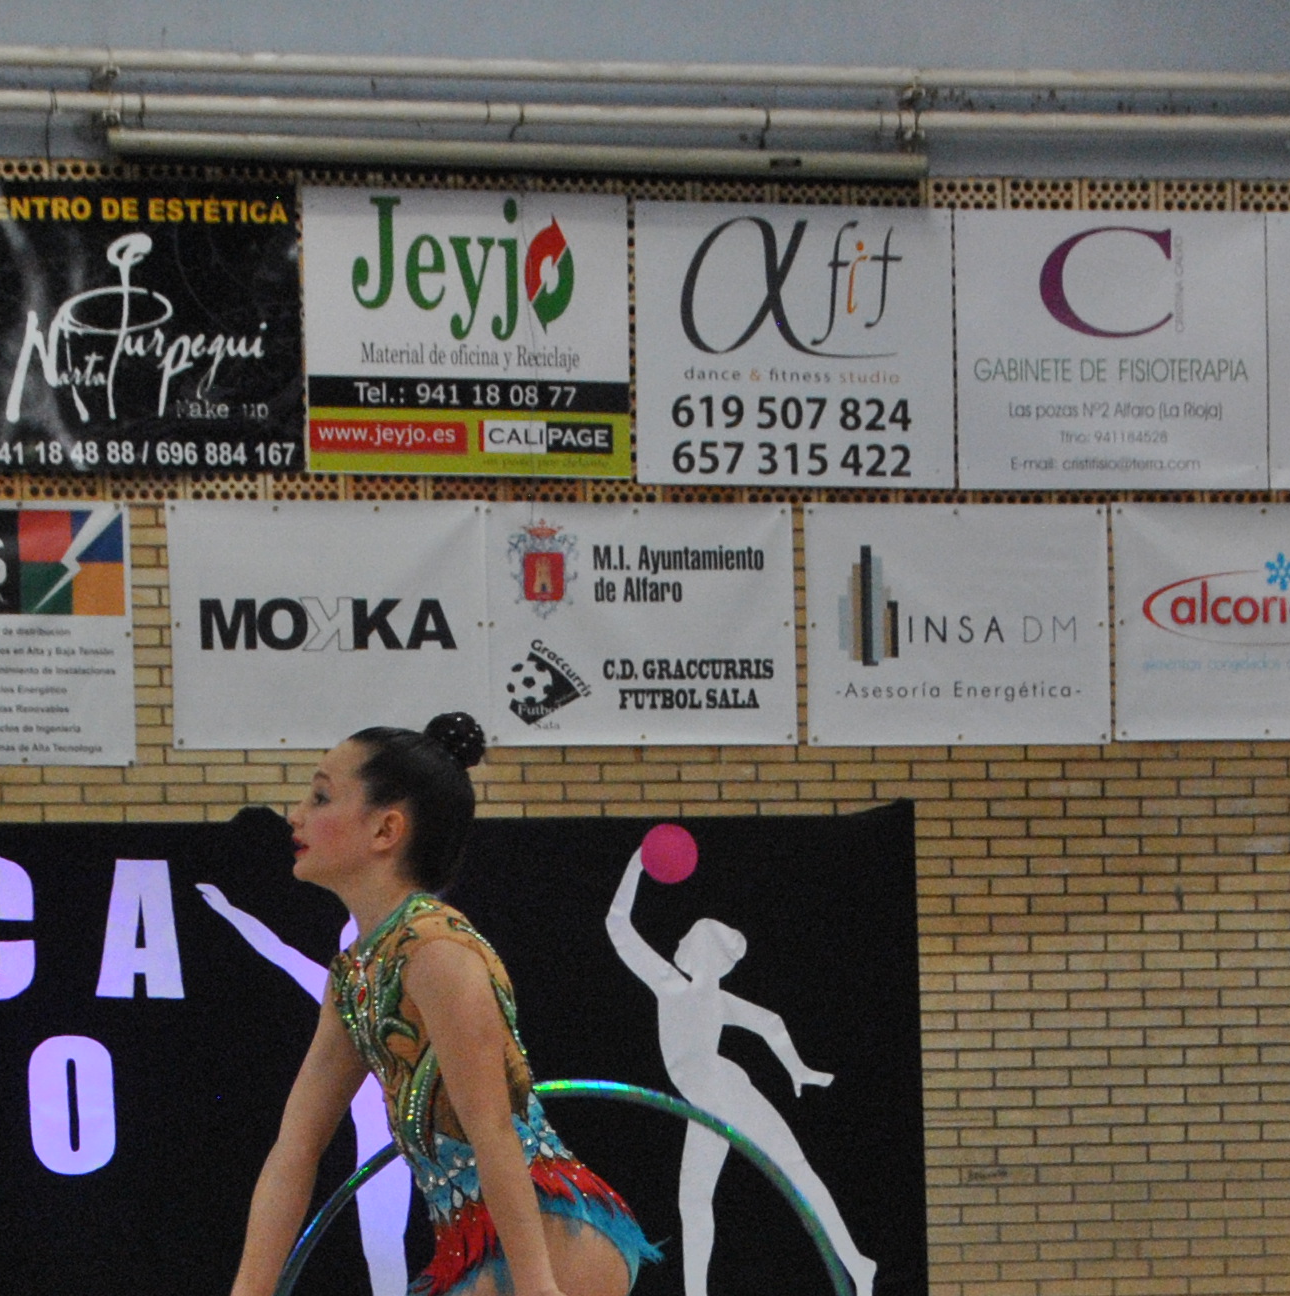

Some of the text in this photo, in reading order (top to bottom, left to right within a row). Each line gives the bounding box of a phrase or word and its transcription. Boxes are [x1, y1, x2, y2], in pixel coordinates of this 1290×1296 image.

[101, 197, 139, 222] DE
[148, 194, 289, 223] ESTÉTICA
[351, 195, 575, 341] Jeyjo
[1039, 225, 1173, 338] C
[361, 342, 580, 373] Material de oficina y Reciclaje
[973, 358, 1248, 383] GABINETE DE FISIOTERAPIA
[684, 366, 901, 384] dance & fitness studio
[416, 384, 459, 405] 941
[472, 384, 500, 405] 18
[509, 385, 539, 406] 08
[548, 386, 577, 407] 77
[671, 394, 912, 432] 619 507 824
[1009, 402, 1031, 417] Las
[1114, 402, 1155, 417] Alfaro
[318, 424, 456, 447] www.jeyjo.es
[35, 442, 63, 466] 18
[71, 442, 99, 466] 48
[106, 442, 135, 466] 88
[156, 442, 198, 466] 696
[205, 442, 248, 466] 884
[255, 442, 295, 466] 167
[672, 440, 912, 477] 657 315 422
[593, 544, 765, 574] M.I. Ayuntamiento
[594, 577, 683, 602] de Alfaro
[908, 615, 1078, 643] INSA DM
[530, 638, 593, 698] Graccurris
[602, 658, 775, 680] C.D. GRACCURRIS
[618, 688, 760, 709] FUTBOL SALA
